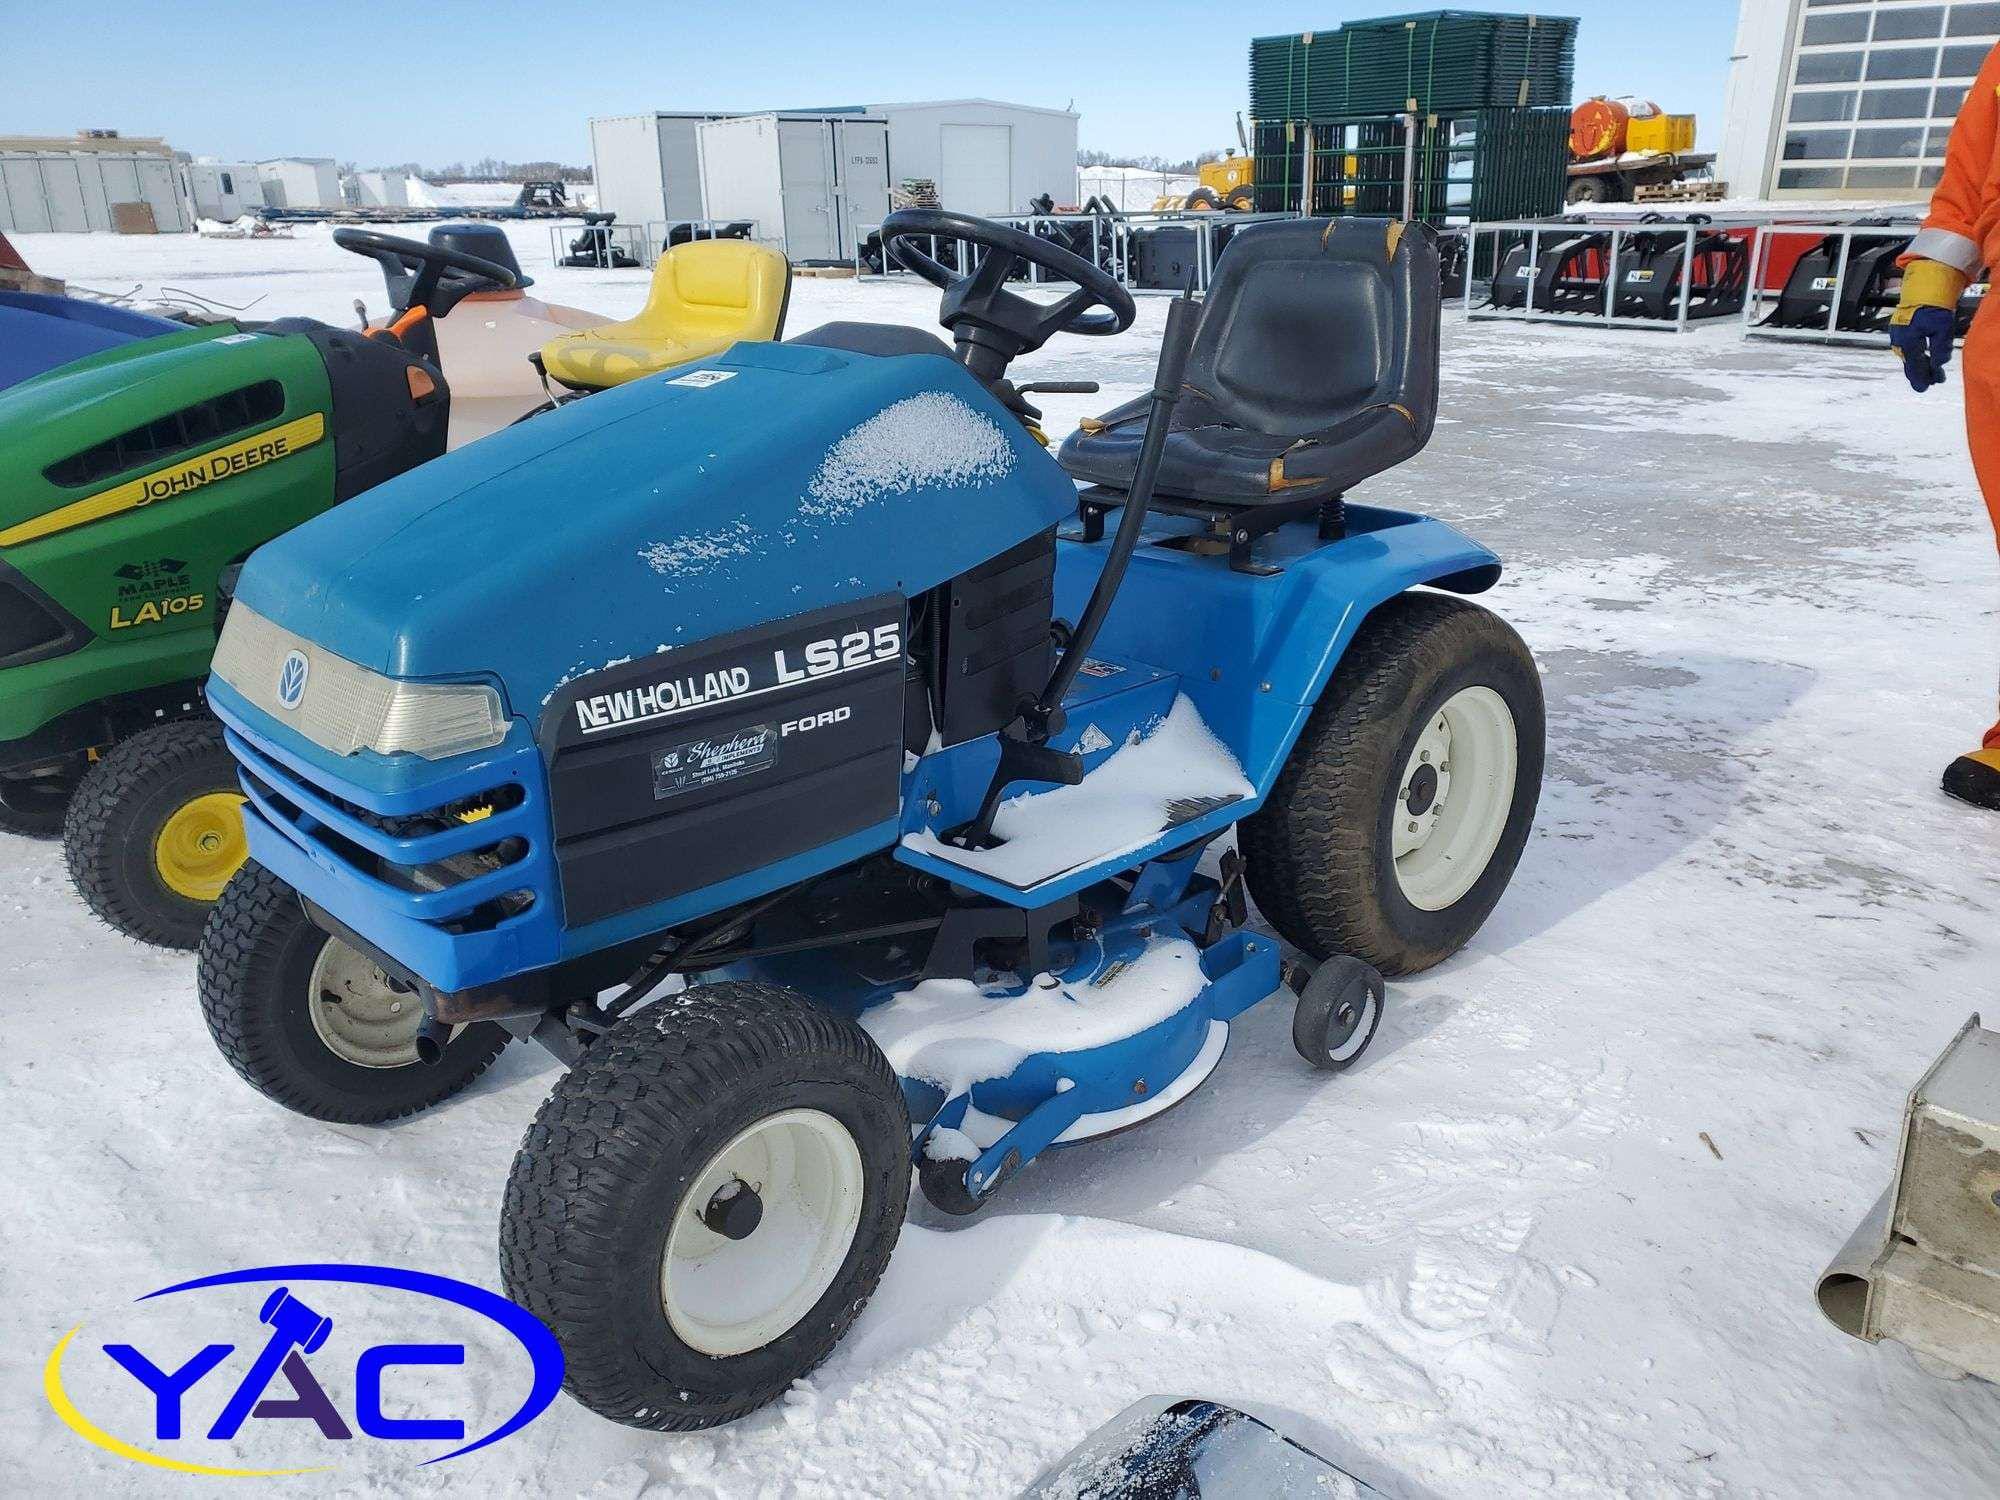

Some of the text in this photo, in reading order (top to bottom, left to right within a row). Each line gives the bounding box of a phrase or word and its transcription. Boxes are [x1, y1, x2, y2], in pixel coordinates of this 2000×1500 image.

[136, 438, 288, 504] JOHN DEERE
[118, 574, 191, 597] MAPLE
[110, 593, 204, 629] LA105
[575, 622, 901, 729] NEW HOLLAND LS25
[781, 706, 851, 737] FORD
[687, 729, 768, 763] Shepherd
